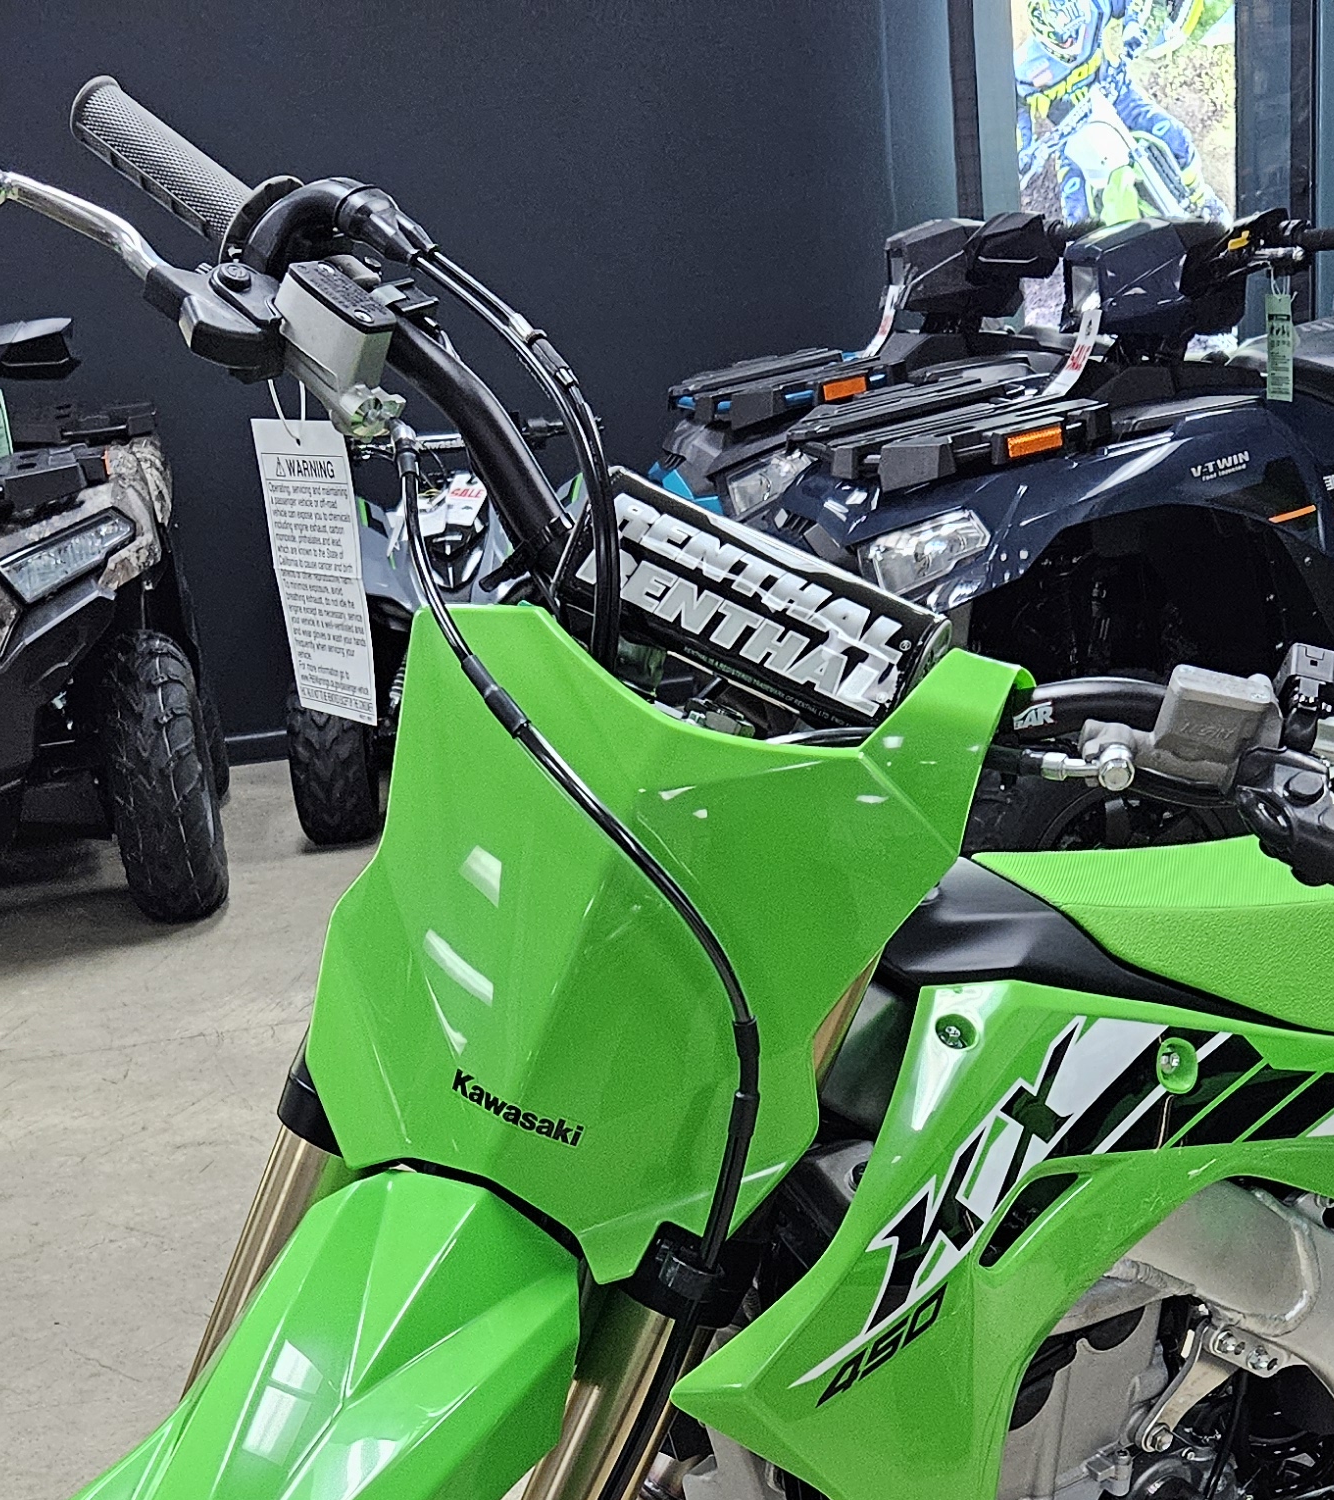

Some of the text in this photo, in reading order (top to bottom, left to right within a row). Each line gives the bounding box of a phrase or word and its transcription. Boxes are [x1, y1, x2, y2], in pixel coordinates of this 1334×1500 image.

[285, 458, 335, 478] WARNING
[451, 488, 485, 498] SALE
[614, 492, 903, 664] RENTHAL
[575, 548, 881, 718] RENTHAL
[452, 1068, 585, 1147] Kawasaki
[815, 1282, 948, 1408] 450
